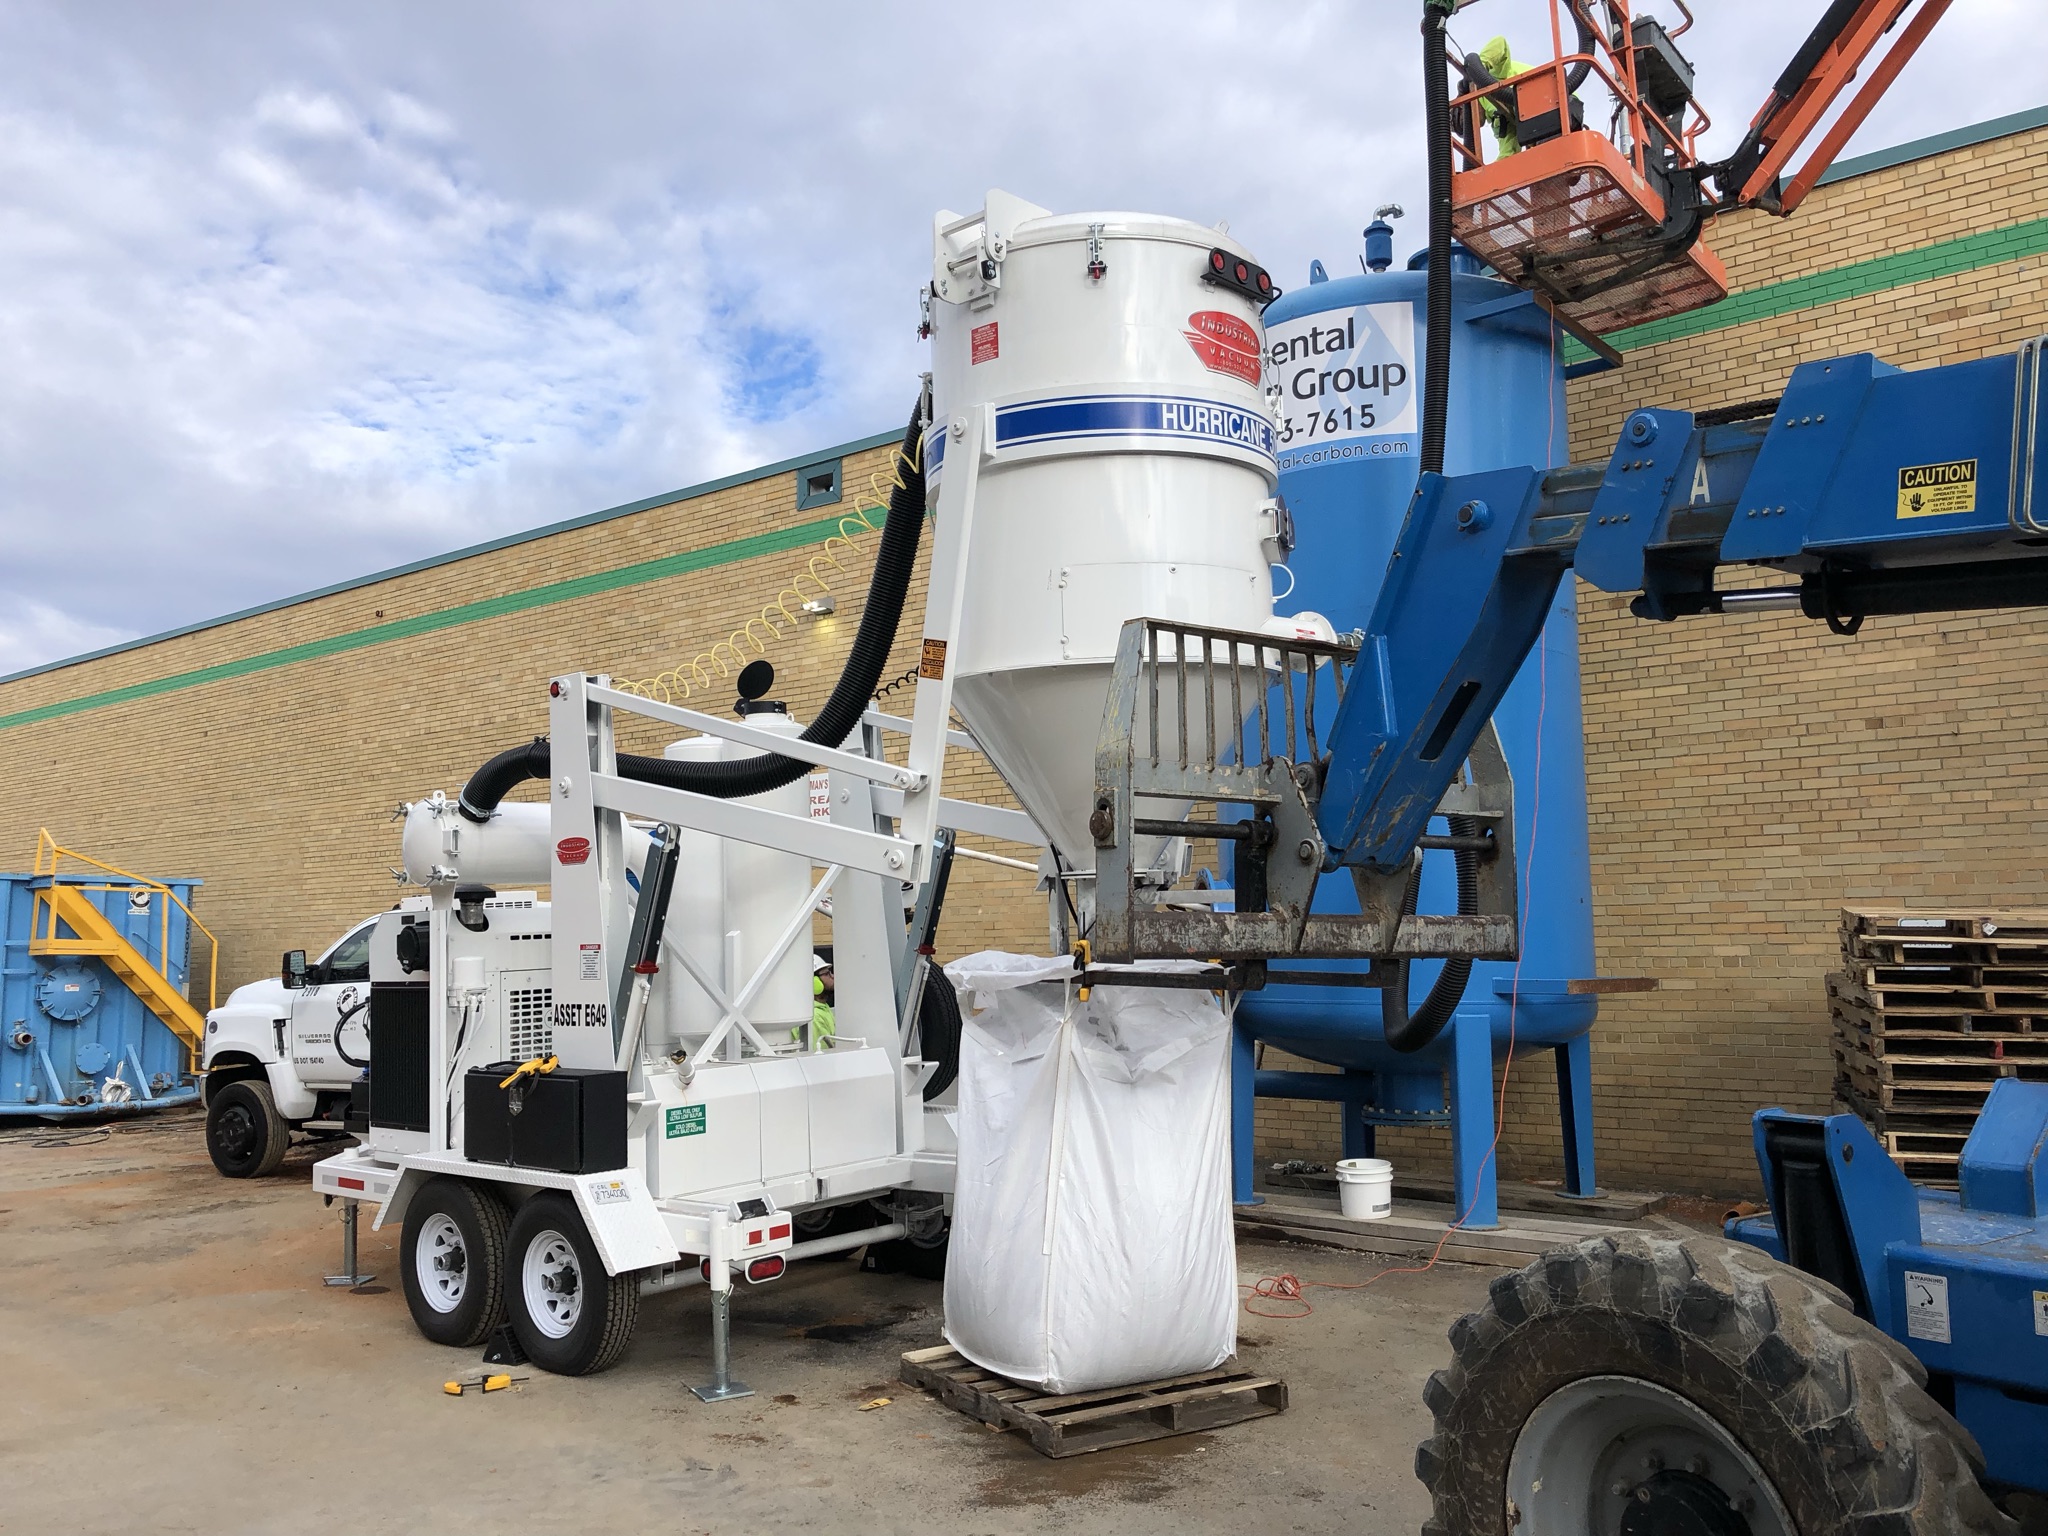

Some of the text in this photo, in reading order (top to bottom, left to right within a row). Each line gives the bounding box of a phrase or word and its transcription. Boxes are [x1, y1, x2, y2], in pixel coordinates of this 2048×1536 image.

[1201, 315, 1258, 352] INDUSTRIAL
[1209, 346, 1256, 371] VACUUM
[1292, 363, 1407, 400] Group
[1162, 403, 1267, 450] HURRICANE
[1689, 458, 1710, 505] A
[1905, 463, 1971, 487] CAUTION
[811, 807, 830, 818] RK
[554, 1003, 607, 1028] ASSET E649
[1914, 1275, 1944, 1285] WARNING
